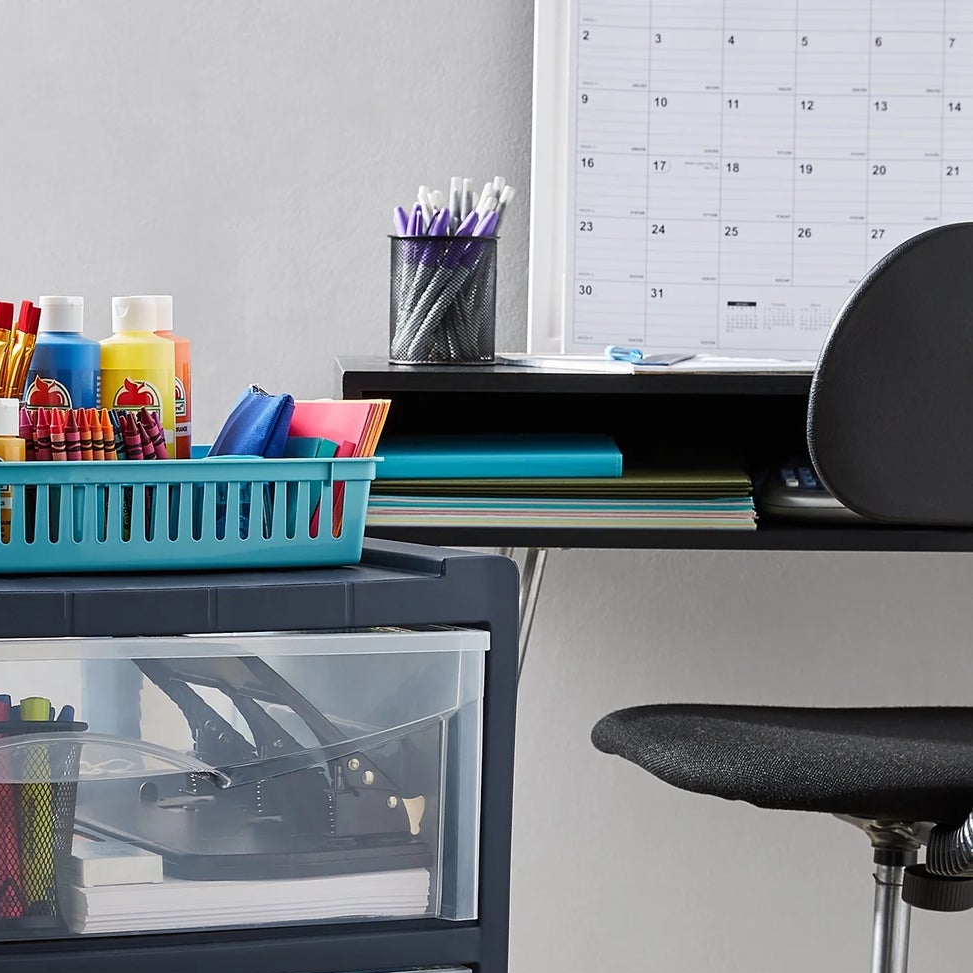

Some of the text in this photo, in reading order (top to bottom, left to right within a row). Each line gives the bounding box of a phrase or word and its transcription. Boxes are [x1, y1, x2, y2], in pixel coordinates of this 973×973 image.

[582, 30, 956, 48] 2 3 4 5 6 7
[581, 93, 962, 112] 9 10 11 12 13 14
[581, 157, 595, 169] 16
[653, 160, 667, 171] 17
[726, 162, 740, 173] 18
[799, 163, 813, 175] 19
[872, 164, 887, 176] 20
[946, 165, 960, 177] 21
[579, 220, 886, 240] 23 24 25 26 27
[578, 284, 663, 299] 30 31
